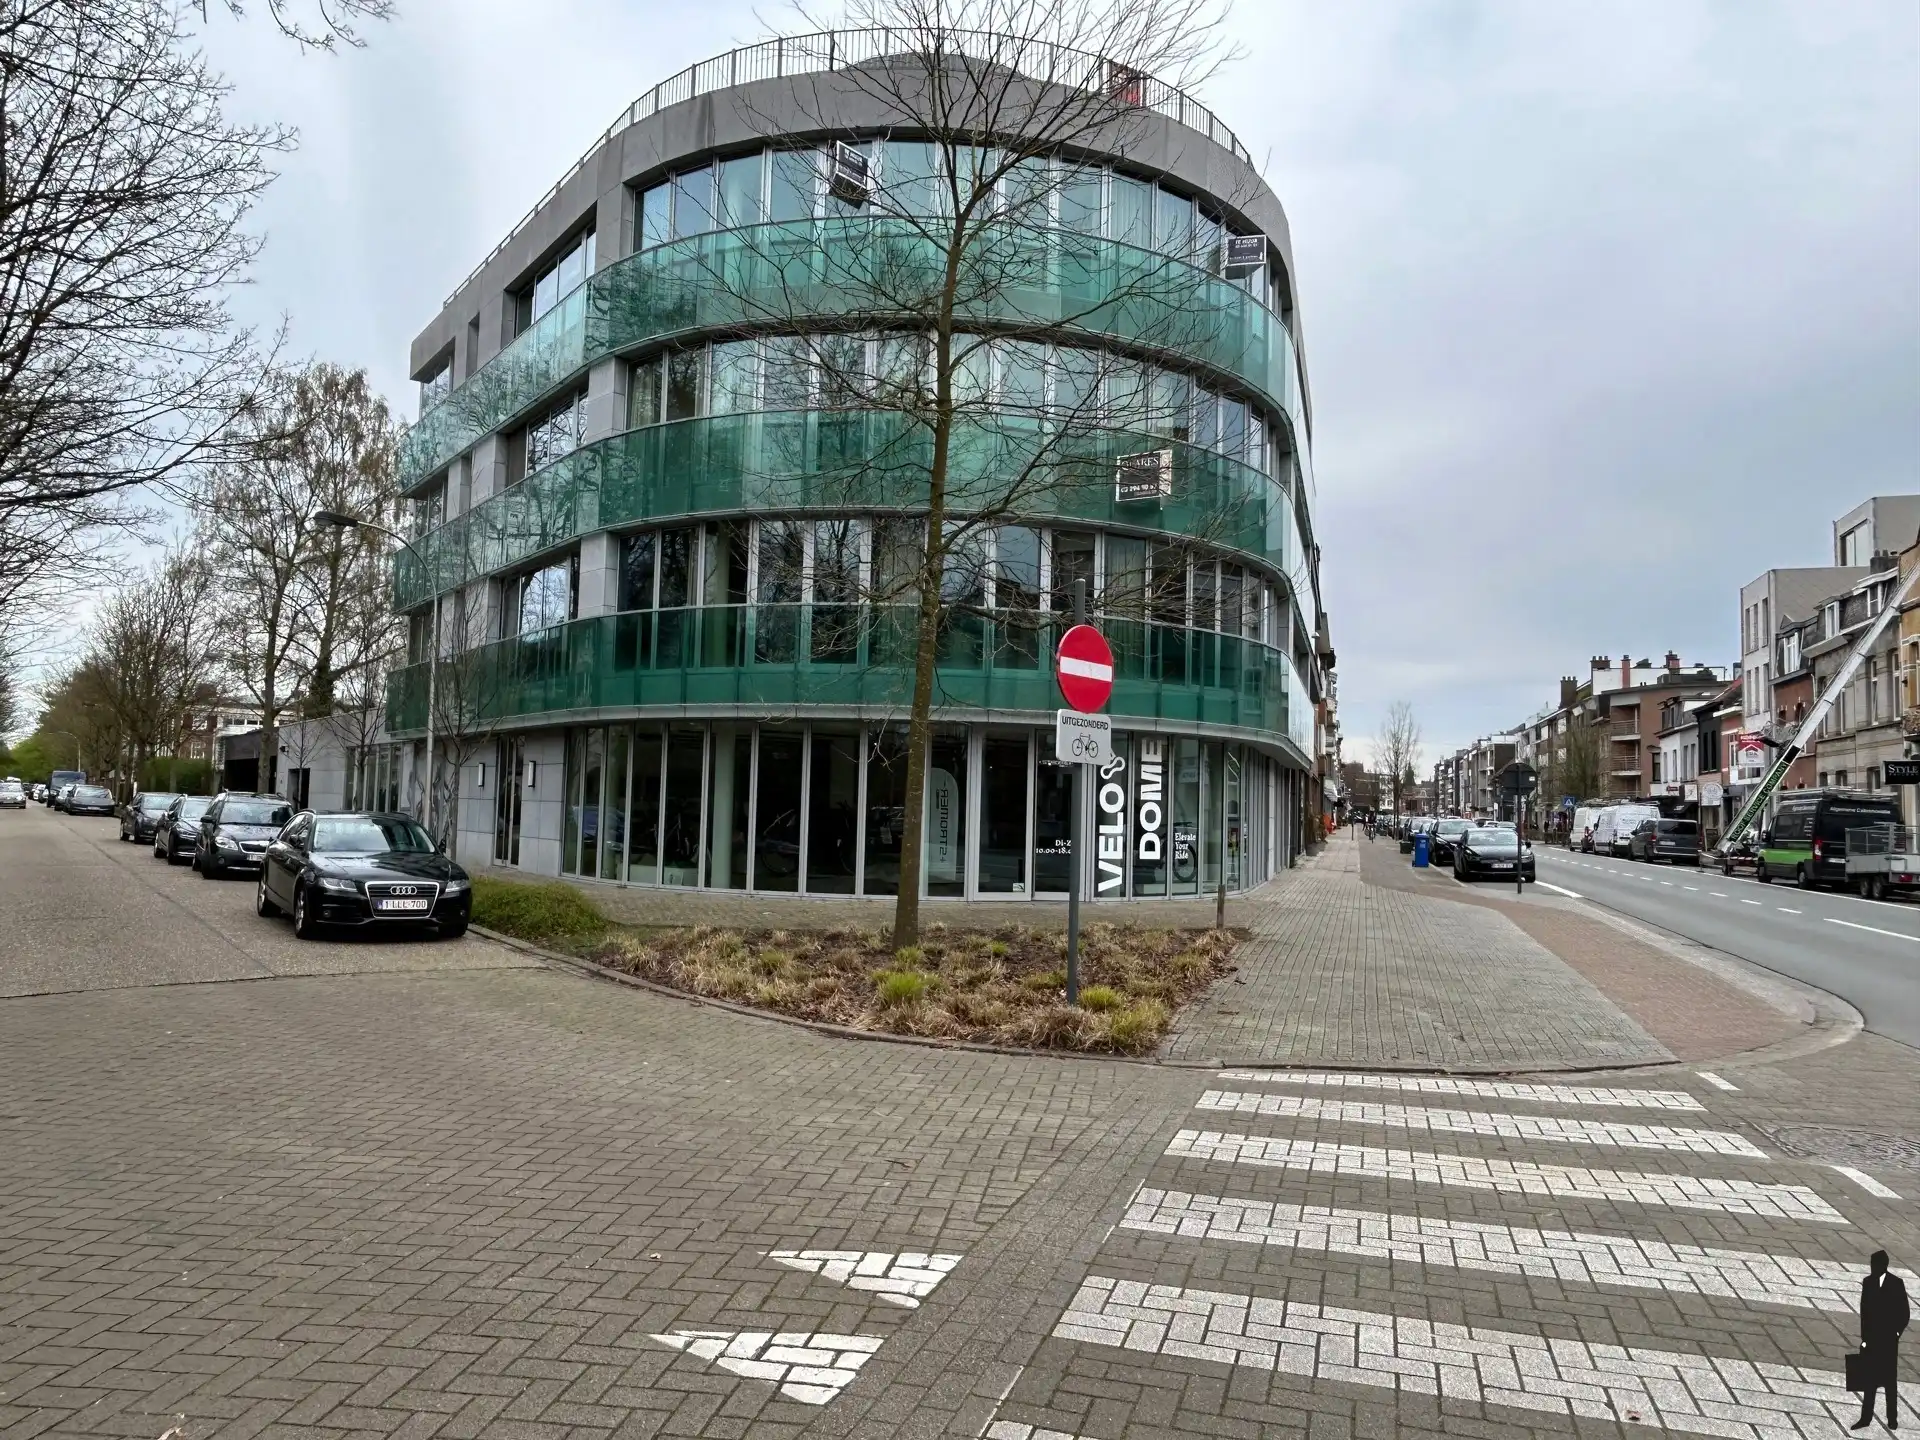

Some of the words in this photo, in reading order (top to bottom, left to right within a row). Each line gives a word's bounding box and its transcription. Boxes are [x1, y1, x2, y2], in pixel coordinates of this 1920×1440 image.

[1062, 715, 1109, 730] UITGEZONDERD
[1888, 764, 1919, 773] STYLE
[1139, 740, 1162, 859] DOME
[1098, 782, 1125, 892] VELO
[1175, 841, 1189, 850] Your
